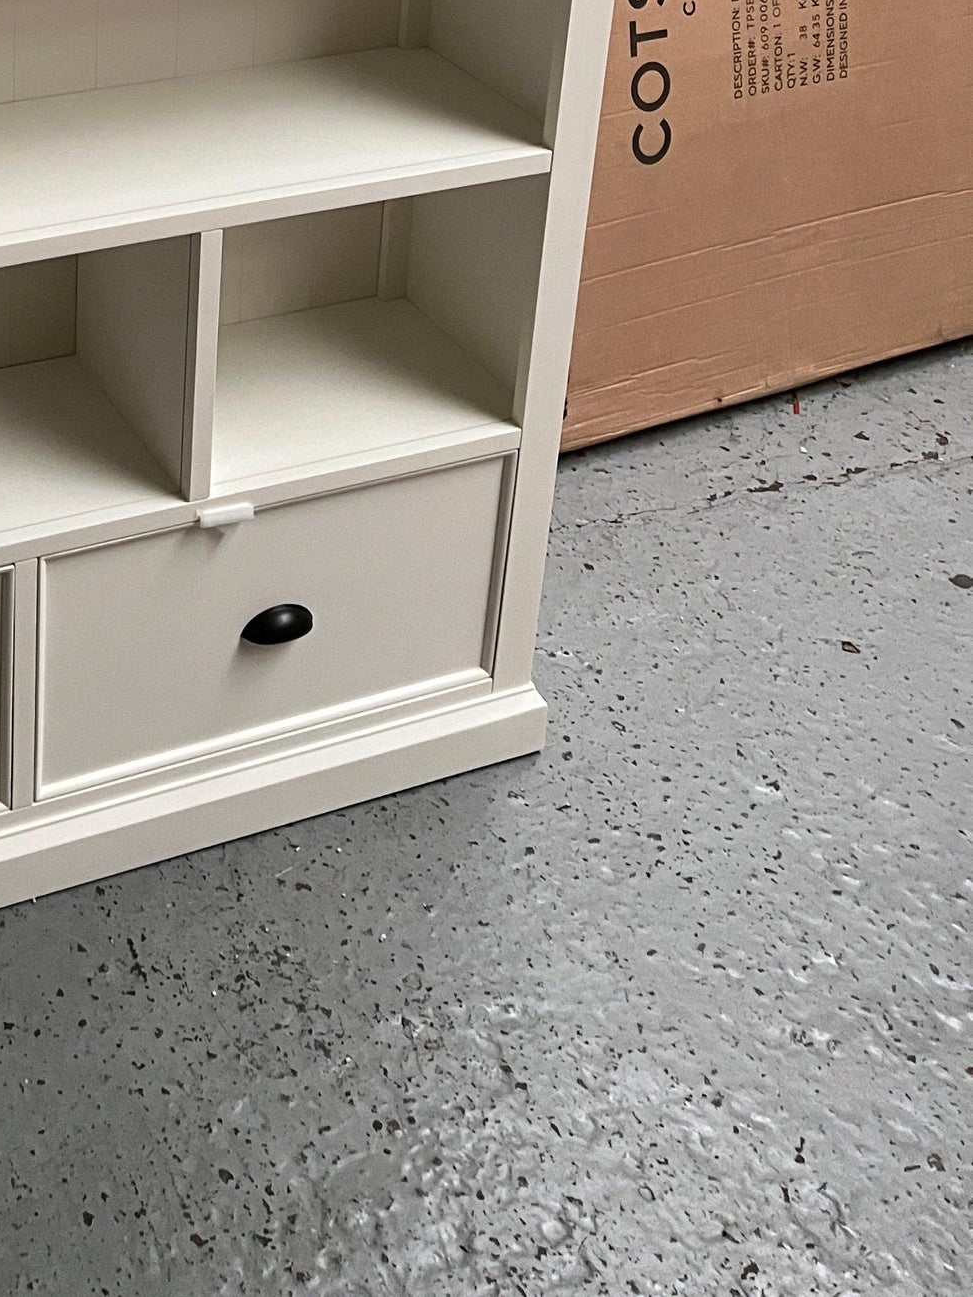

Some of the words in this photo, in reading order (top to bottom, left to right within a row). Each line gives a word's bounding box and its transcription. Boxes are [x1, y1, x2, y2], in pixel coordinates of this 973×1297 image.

[773, 0, 781, 17] OF
[761, 26, 769, 50] 609
[799, 25, 807, 40] 38
[812, 14, 820, 48] 64.35
[839, 13, 848, 78] DESIGNED
[732, 7, 743, 99] DESCRIPTION:
[748, 37, 756, 96] ORDER#:
[774, 33, 783, 91] CARTON:
[800, 57, 808, 86] N.W:
[813, 55, 821, 84] G.W:
